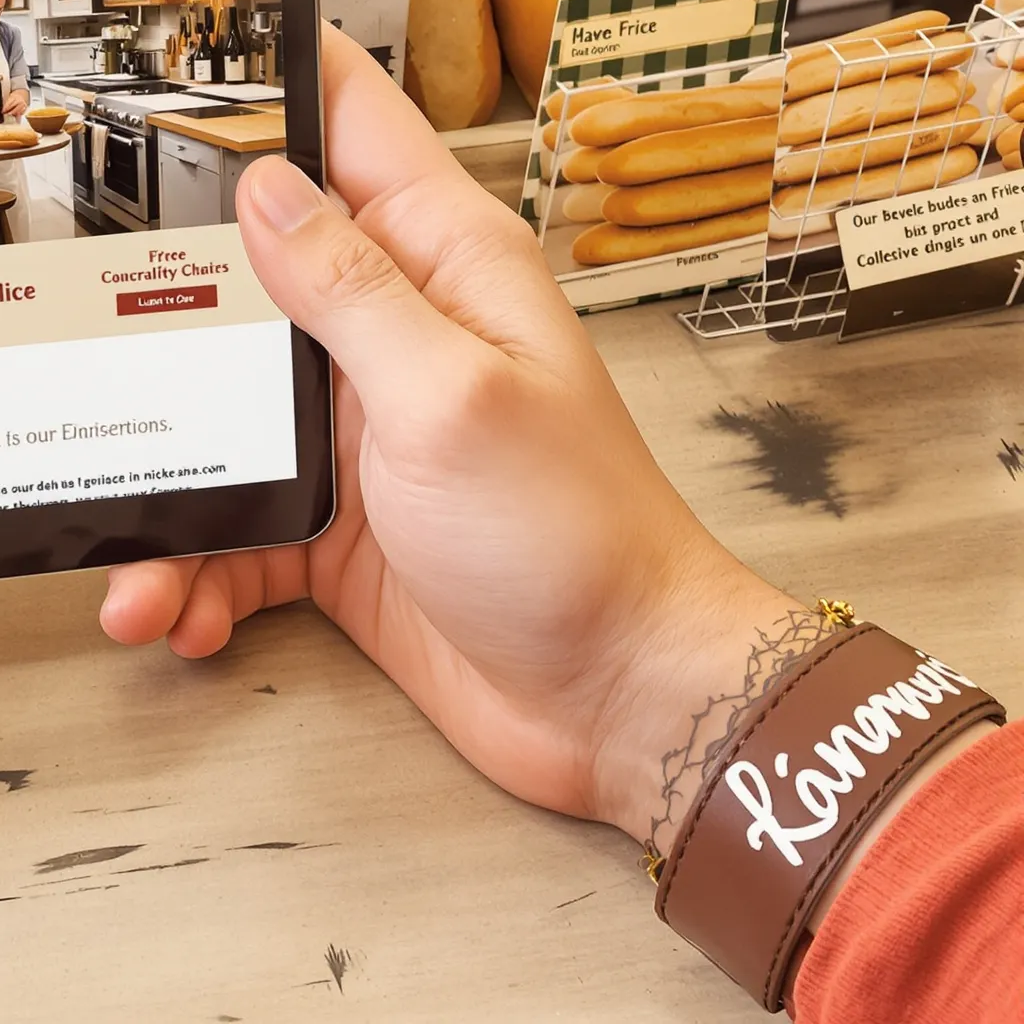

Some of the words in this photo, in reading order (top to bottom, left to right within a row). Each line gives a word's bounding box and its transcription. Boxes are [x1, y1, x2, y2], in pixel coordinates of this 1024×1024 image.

[571, 27, 612, 44] Have
[852, 213, 878, 228] Our
[971, 191, 988, 204] an
[992, 224, 1017, 240] one
[25, 429, 58, 445] our
